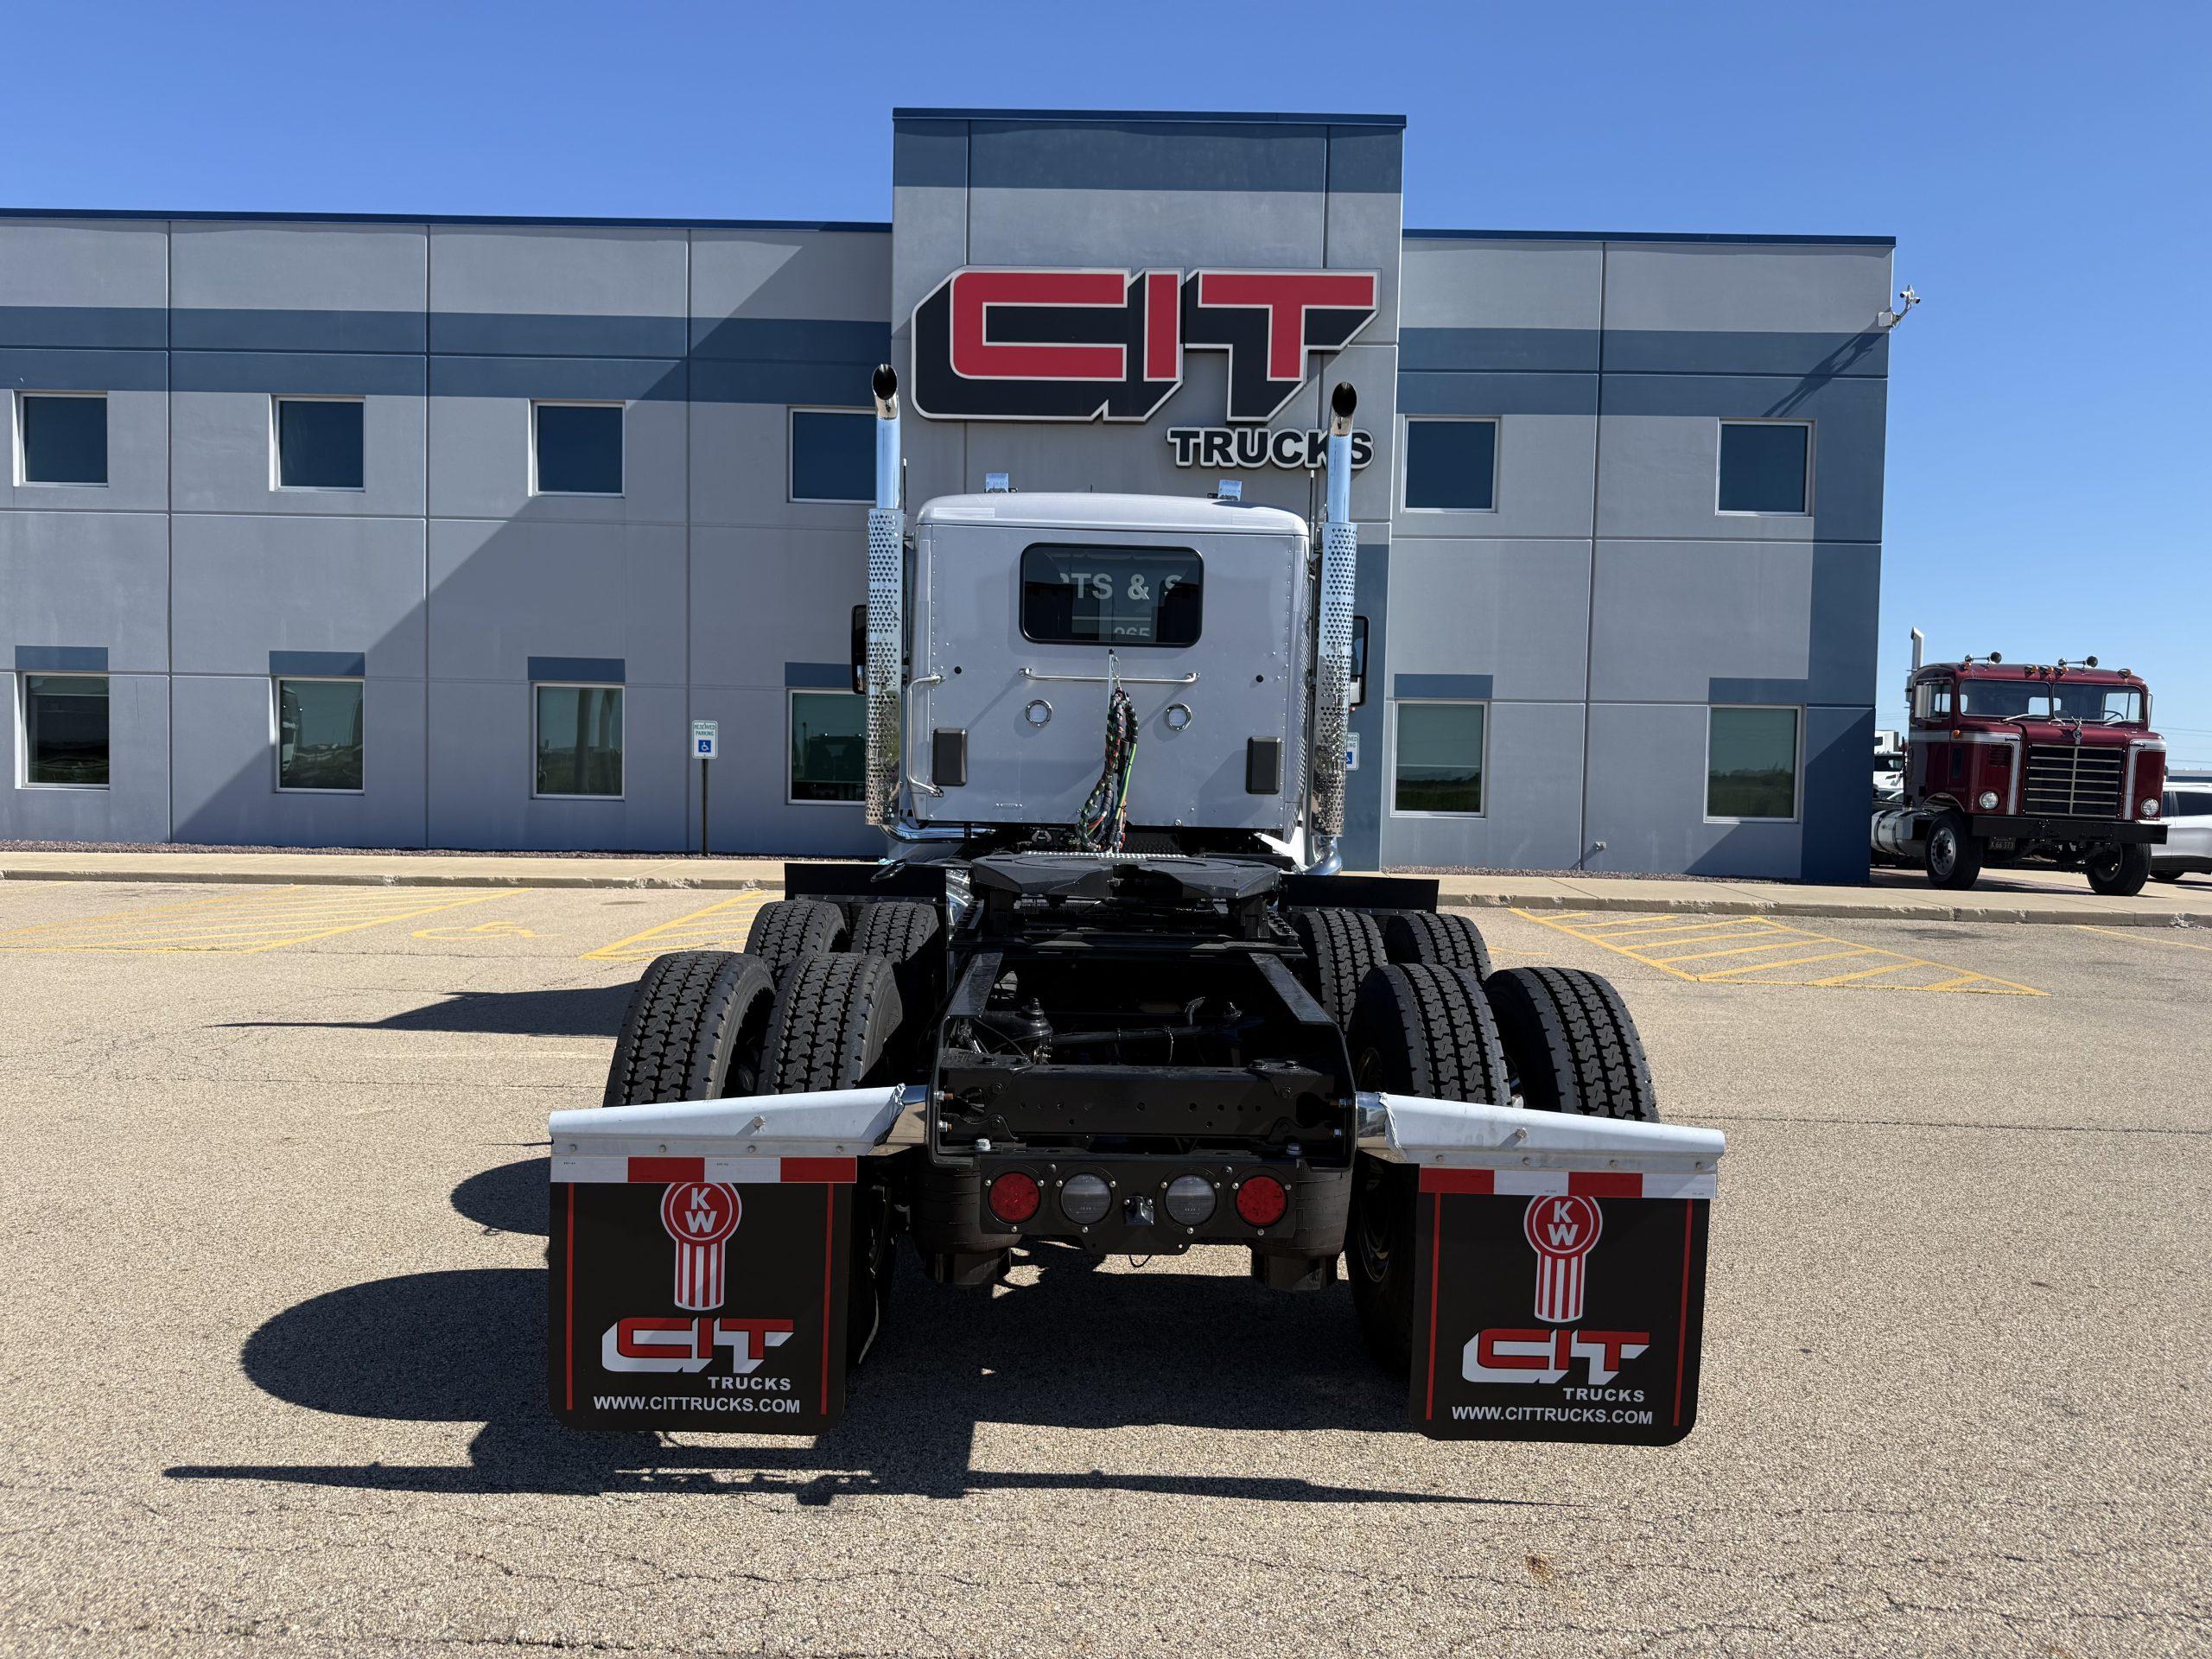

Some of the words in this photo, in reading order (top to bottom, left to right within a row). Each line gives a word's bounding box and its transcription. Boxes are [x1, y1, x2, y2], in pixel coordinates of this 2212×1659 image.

[912, 266, 1380, 422] CIT
[1166, 427, 1375, 469] TRUCKS
[1059, 572, 1113, 600] TS
[1128, 574, 1149, 601] &
[690, 1187, 710, 1210] K
[685, 1211, 717, 1233] W
[1553, 1200, 1573, 1223] K
[1547, 1224, 1579, 1246] W
[602, 1317, 794, 1374] CIT
[1462, 1328, 1649, 1385] CIT
[708, 1376, 791, 1391] TRUCKS
[1562, 1388, 1645, 1402] TRUCKS
[593, 1395, 801, 1414] WWW.CITTRUCKS.COM
[1451, 1406, 1654, 1425] WWW.CITTRUCKS.COM
